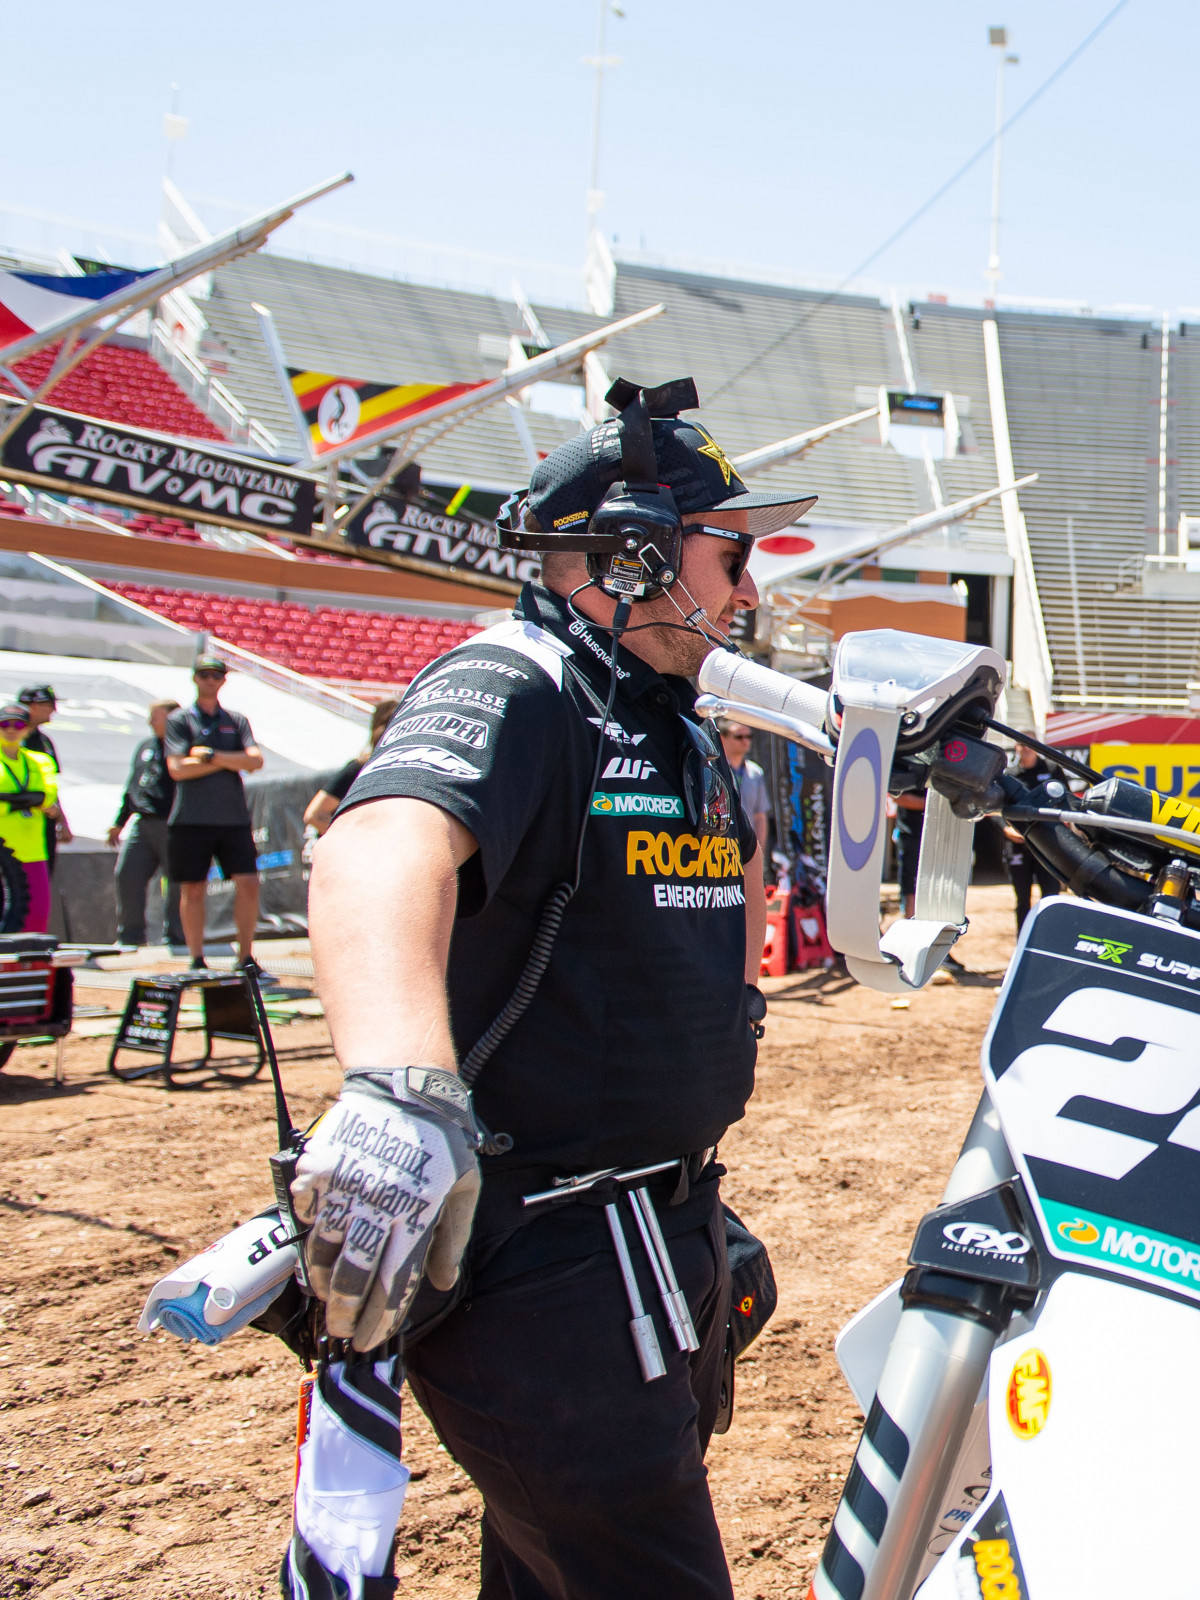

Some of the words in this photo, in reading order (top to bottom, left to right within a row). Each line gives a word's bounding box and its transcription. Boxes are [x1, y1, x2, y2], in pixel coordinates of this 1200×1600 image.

[76, 423, 169, 465] ROCKY
[167, 448, 301, 499] MOUNTAIN
[33, 445, 171, 494] ATV
[178, 479, 297, 524] MC
[401, 503, 468, 539] ROCKY
[553, 511, 589, 528] ROCKSTAR
[368, 524, 470, 563] ATV
[612, 578, 638, 593] AMOS
[386, 715, 486, 746] PROTAPER
[601, 757, 658, 780] WP
[615, 796, 680, 815] MOTOREX
[627, 831, 745, 878] ROCKSTAR
[653, 884, 714, 909] ENERGY
[329, 1108, 433, 1180] Mechanix
[328, 1153, 432, 1228] Mechanix
[941, 1240, 989, 1257] FACTORY
[1008, 1352, 1043, 1437] FMF
